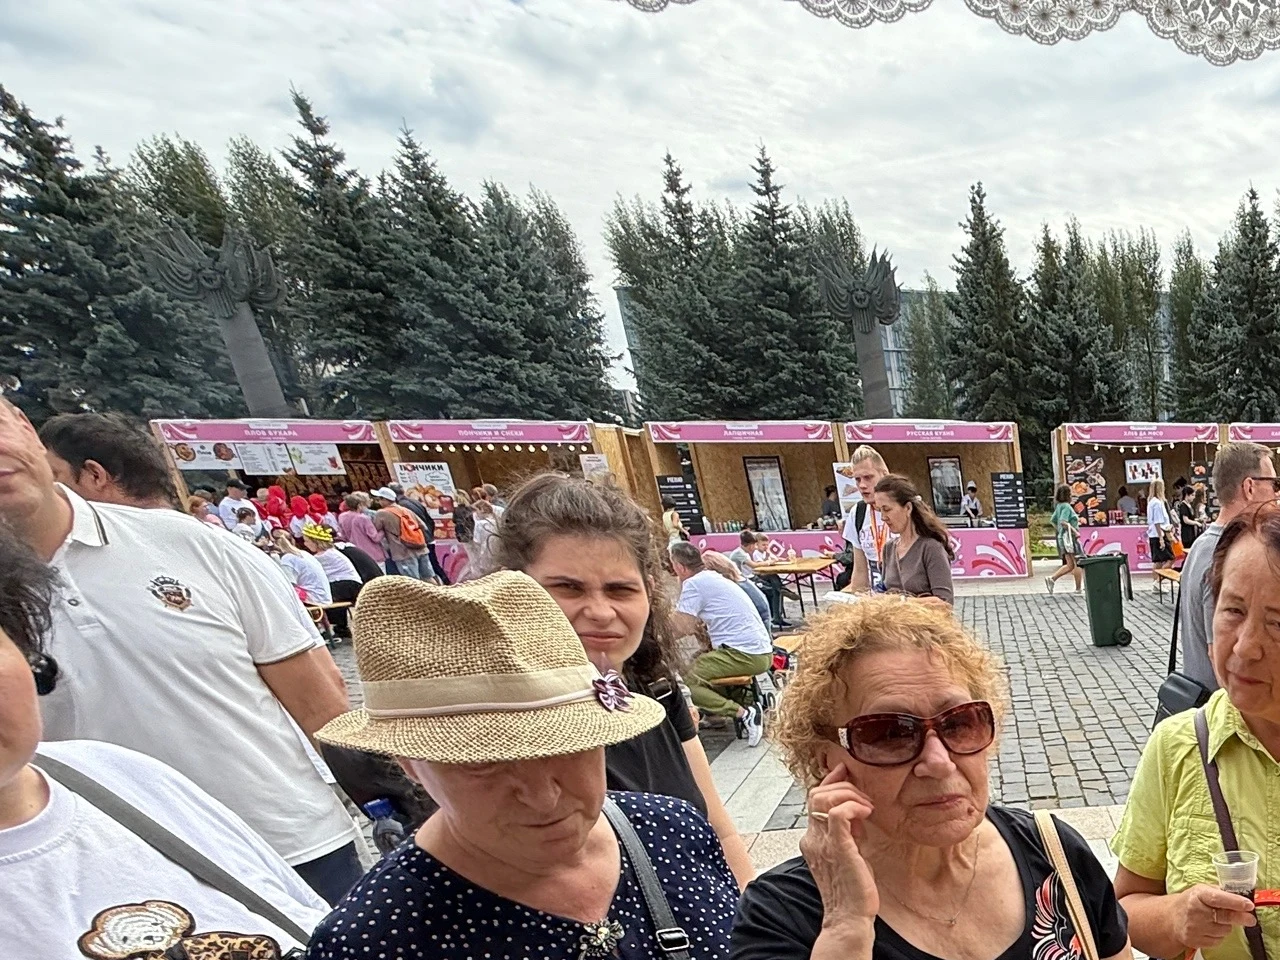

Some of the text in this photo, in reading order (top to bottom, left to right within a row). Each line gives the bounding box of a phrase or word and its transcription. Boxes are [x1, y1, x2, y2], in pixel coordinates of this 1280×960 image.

[244, 429, 298, 437] ПЛОВ БУХАРА
[458, 429, 524, 437] ПОНЧИКИ И СНЕКИ
